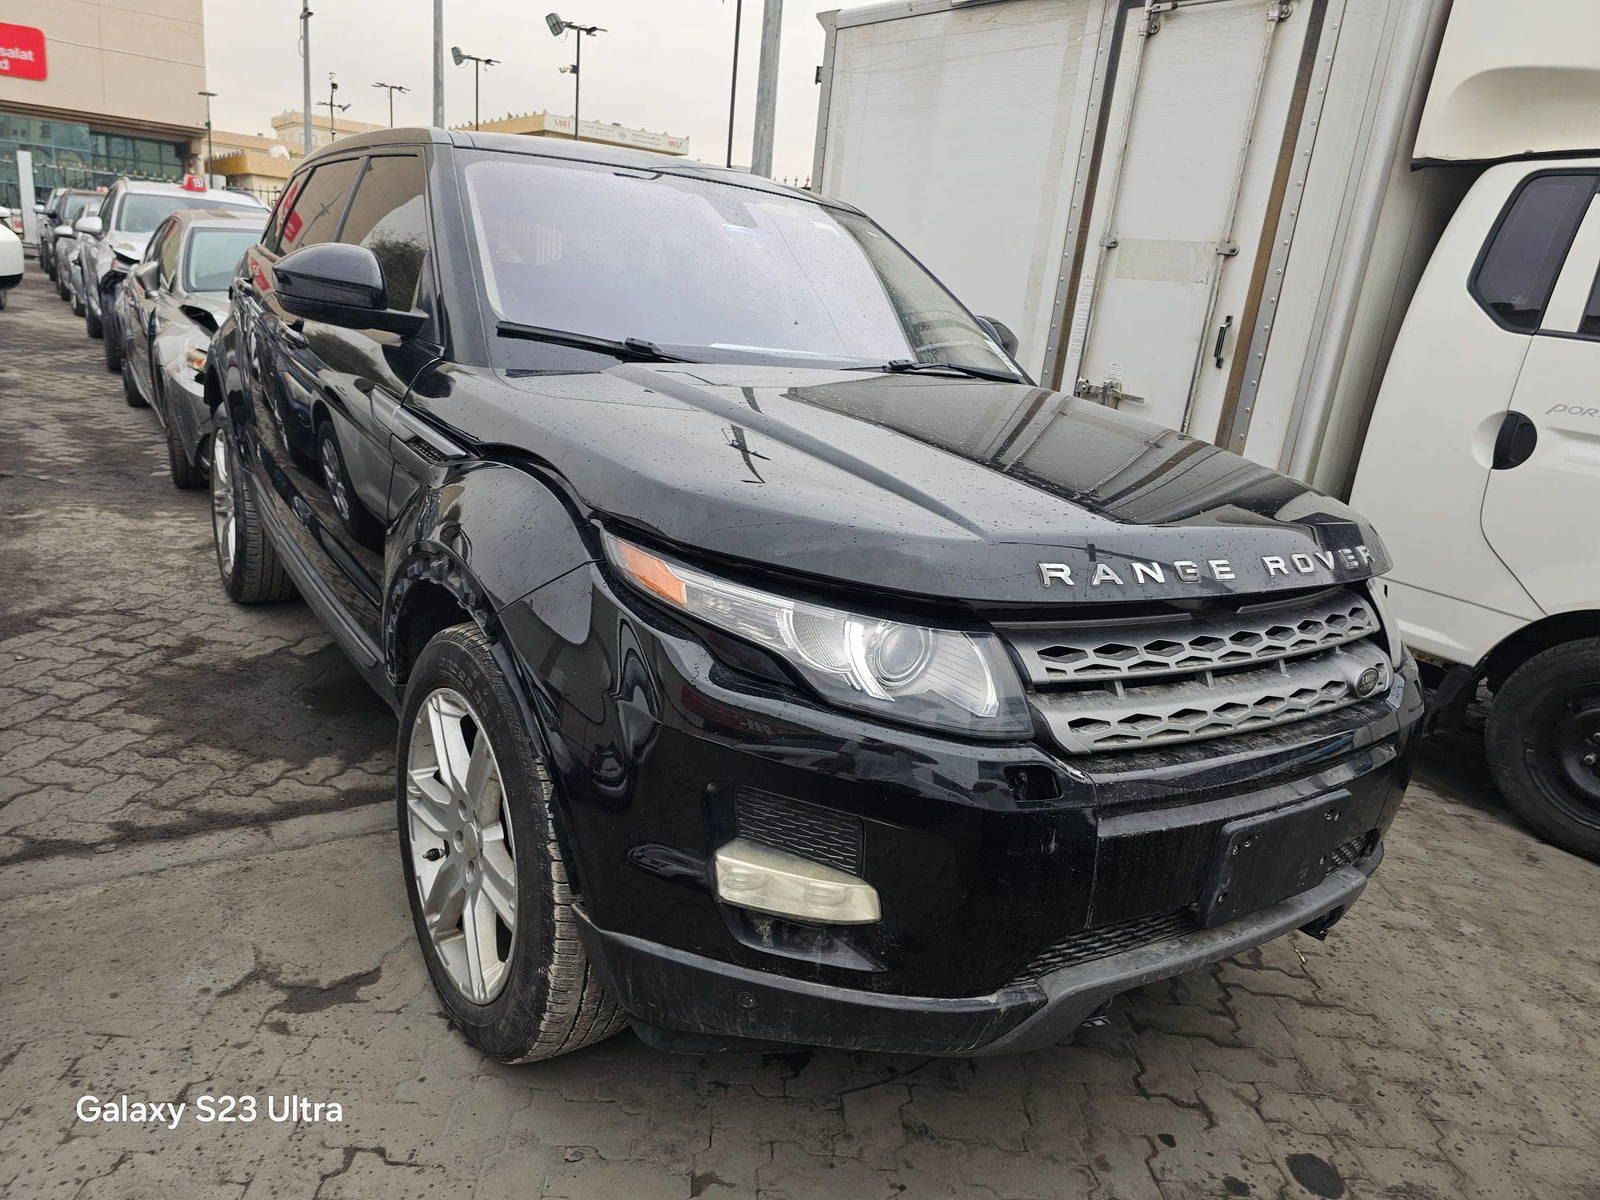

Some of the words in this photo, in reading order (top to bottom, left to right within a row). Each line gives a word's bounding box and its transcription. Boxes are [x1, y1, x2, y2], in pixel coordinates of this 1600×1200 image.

[1545, 403, 1600, 418] POR
[1038, 559, 1236, 588] RANGE
[1262, 545, 1375, 577] ROVER
